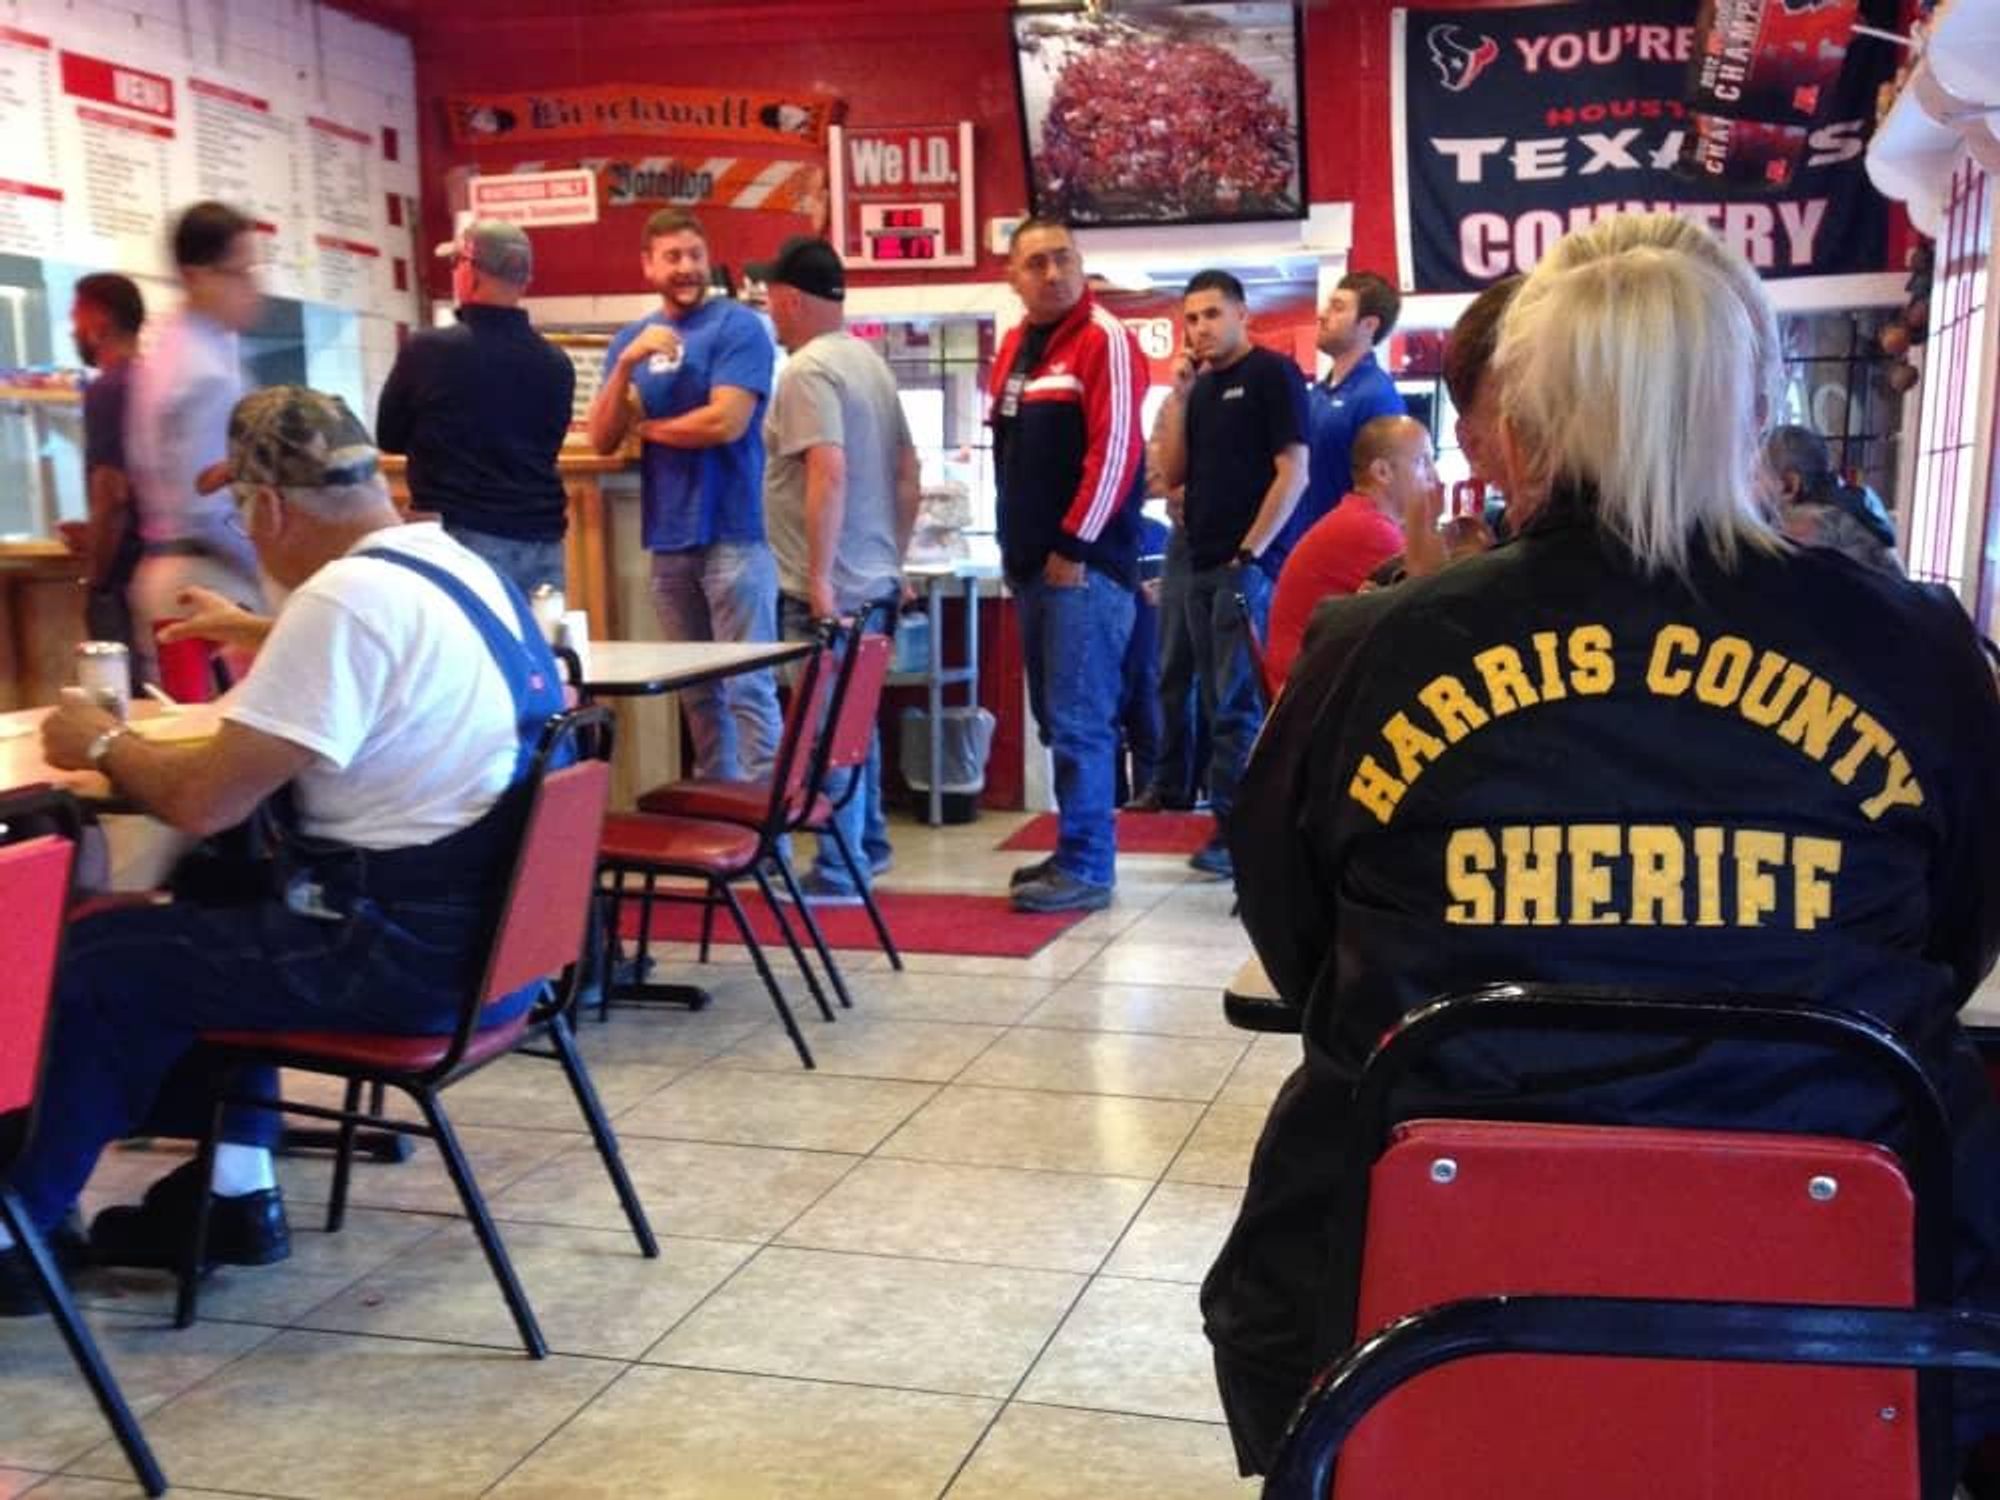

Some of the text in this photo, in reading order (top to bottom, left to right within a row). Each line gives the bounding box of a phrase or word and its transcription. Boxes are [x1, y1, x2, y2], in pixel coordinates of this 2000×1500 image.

[1514, 25, 1696, 73] YOU'RE
[1545, 98, 1690, 128] HOUST
[850, 137, 904, 188] We
[1459, 199, 1828, 279] CORY
[1349, 624, 1925, 825] HARRIS COUNTY
[1445, 824, 1842, 930] SHERIFF
